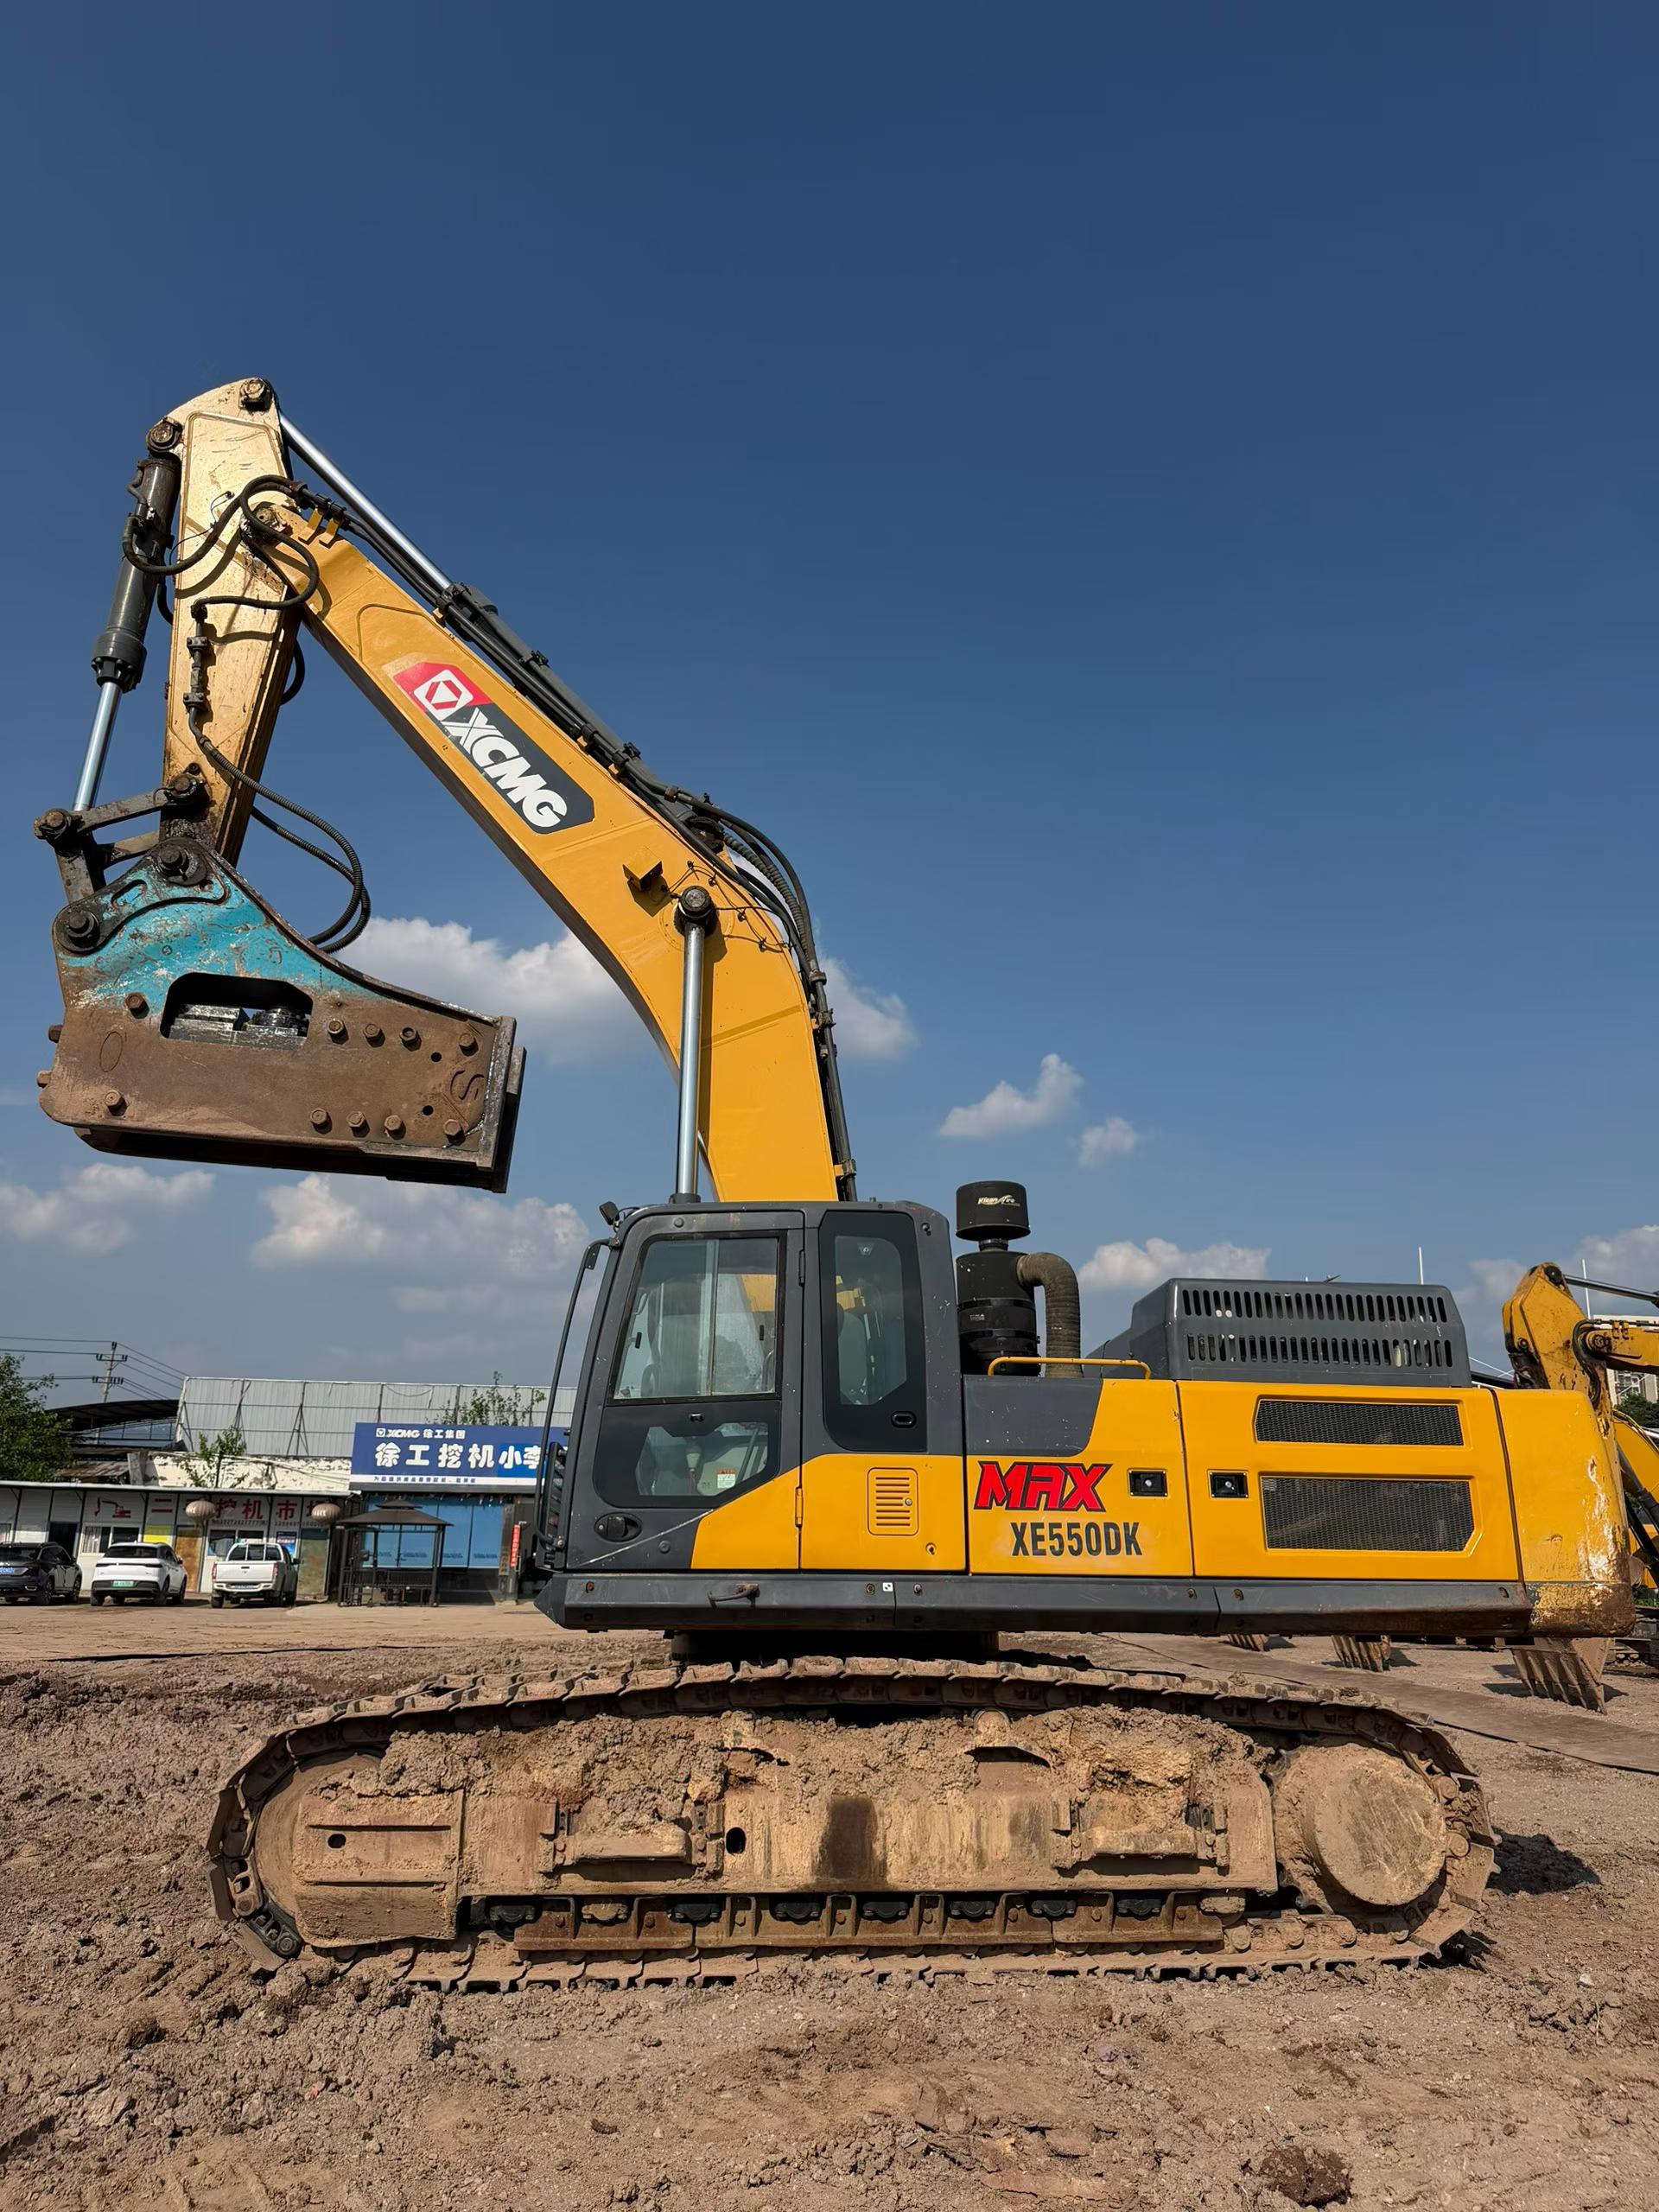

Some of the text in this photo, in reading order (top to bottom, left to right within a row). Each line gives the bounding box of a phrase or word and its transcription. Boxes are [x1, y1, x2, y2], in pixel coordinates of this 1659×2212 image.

[441, 707, 568, 828] XCMG
[385, 1428, 420, 1439] XCMG
[974, 1460, 1113, 1512] MAX
[1010, 1522, 1142, 1556] XE550DK
